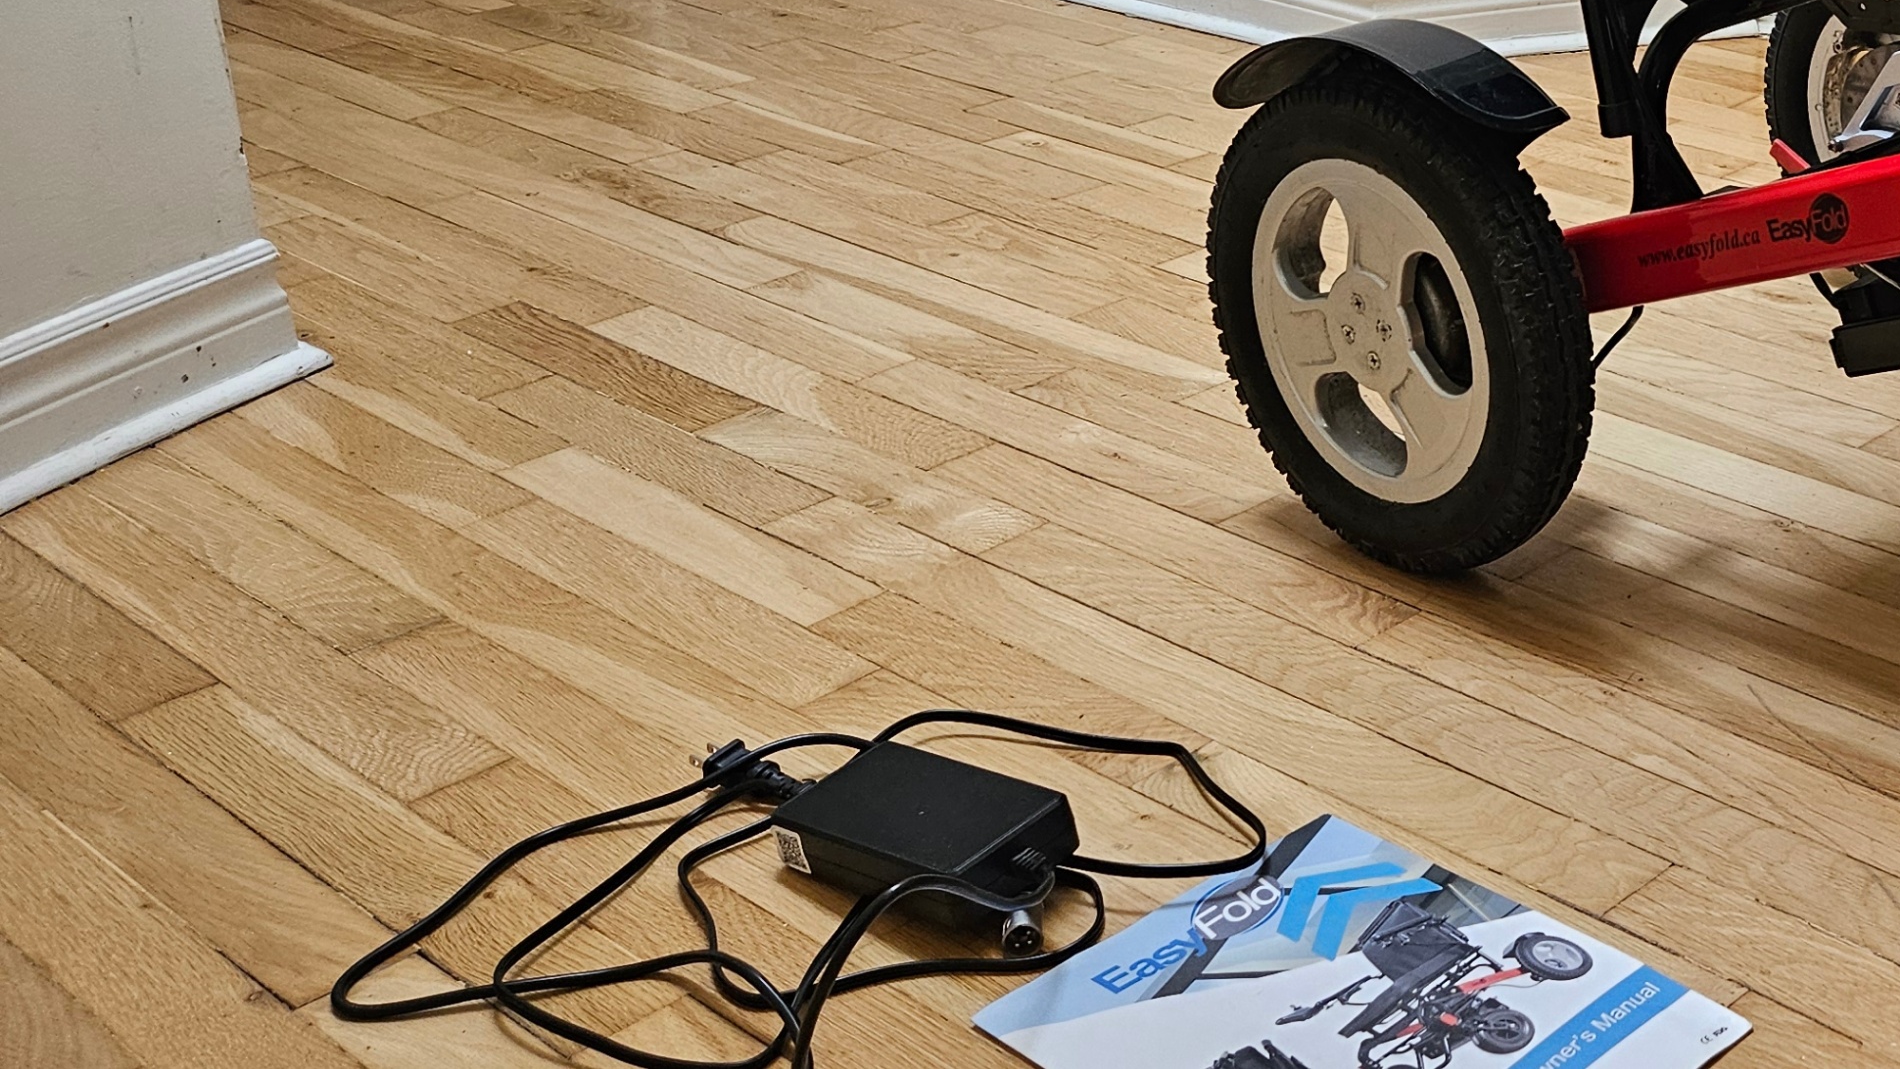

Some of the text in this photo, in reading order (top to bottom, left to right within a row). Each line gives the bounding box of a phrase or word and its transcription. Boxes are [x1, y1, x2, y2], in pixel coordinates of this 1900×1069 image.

[1637, 204, 1848, 268] www.easyfold.ca EasyFold
[1091, 877, 1281, 994] EasyFold
[1539, 981, 1661, 1069] ner's Manual
